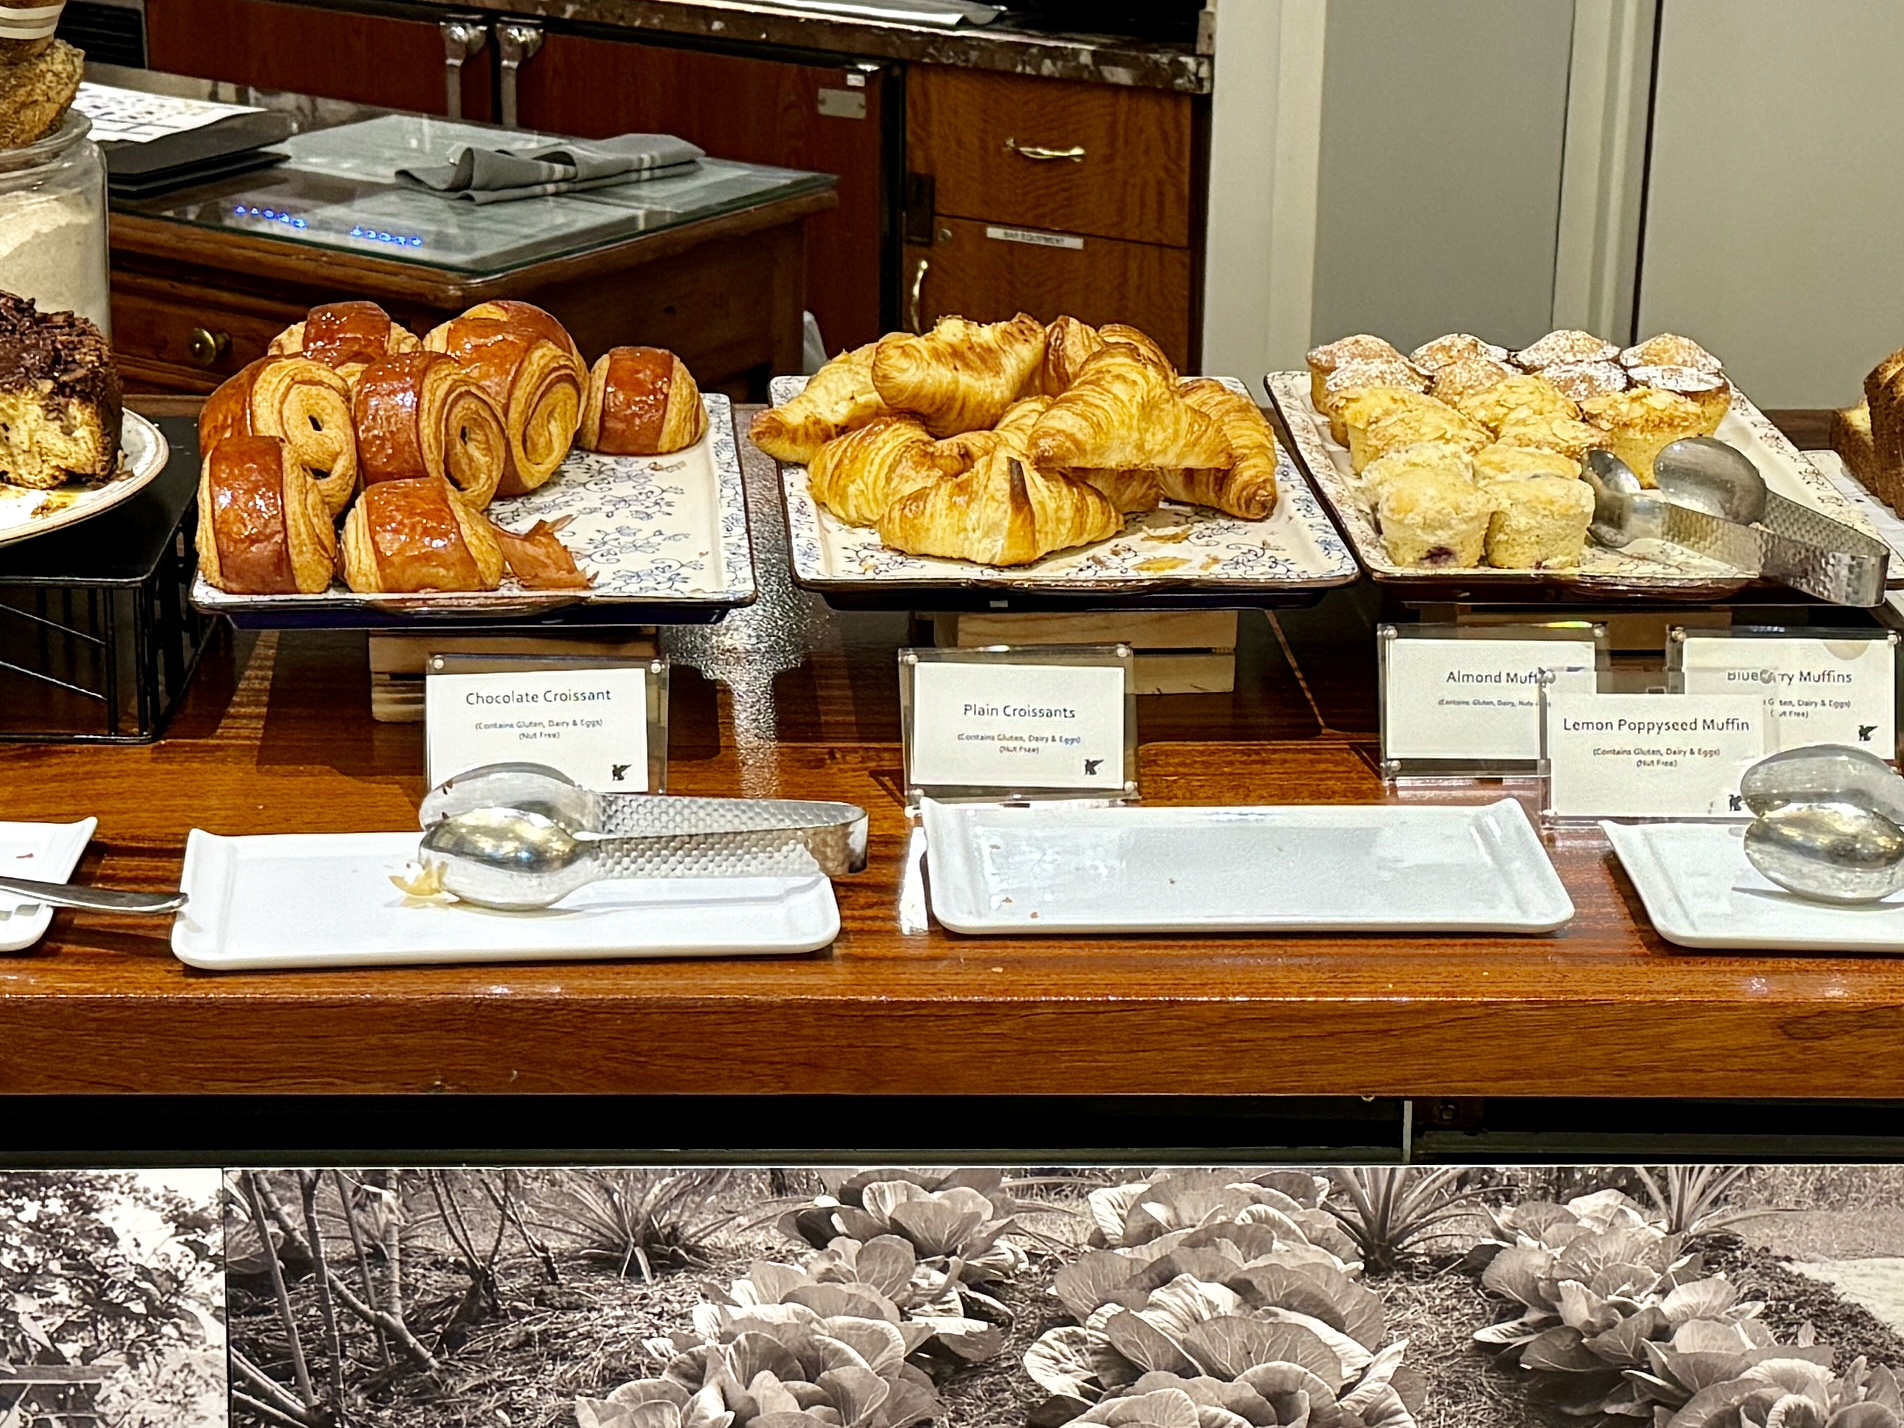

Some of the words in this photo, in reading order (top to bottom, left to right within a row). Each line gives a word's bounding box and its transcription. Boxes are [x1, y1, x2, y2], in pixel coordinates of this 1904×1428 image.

[1446, 670, 1502, 683] Almond
[1506, 671, 1543, 684] Muff
[1799, 670, 1853, 684] Muffins
[466, 690, 539, 705] Chocolate
[543, 689, 612, 703] Croissant
[1797, 699, 1818, 708] Dairy
[963, 703, 999, 716] Plain
[1003, 704, 1076, 718] Croissants
[475, 722, 514, 731] (Contains
[516, 720, 545, 729] Gluten,
[548, 719, 569, 728] Dairy
[572, 719, 578, 727] &
[1563, 718, 1614, 731] Lemon
[1618, 717, 1698, 735] Poppyseed
[1702, 717, 1750, 731] Muffin
[957, 733, 995, 742] (Contains
[997, 733, 1026, 743] Gluten,
[1028, 734, 1049, 744] Dairy
[1051, 735, 1056, 743] &
[1593, 747, 1632, 757] (Contains
[1633, 747, 1663, 757] Gluten,
[1665, 748, 1687, 757] Dairy
[1689, 748, 1695, 756] &
[1697, 748, 1720, 759] Eggs)
